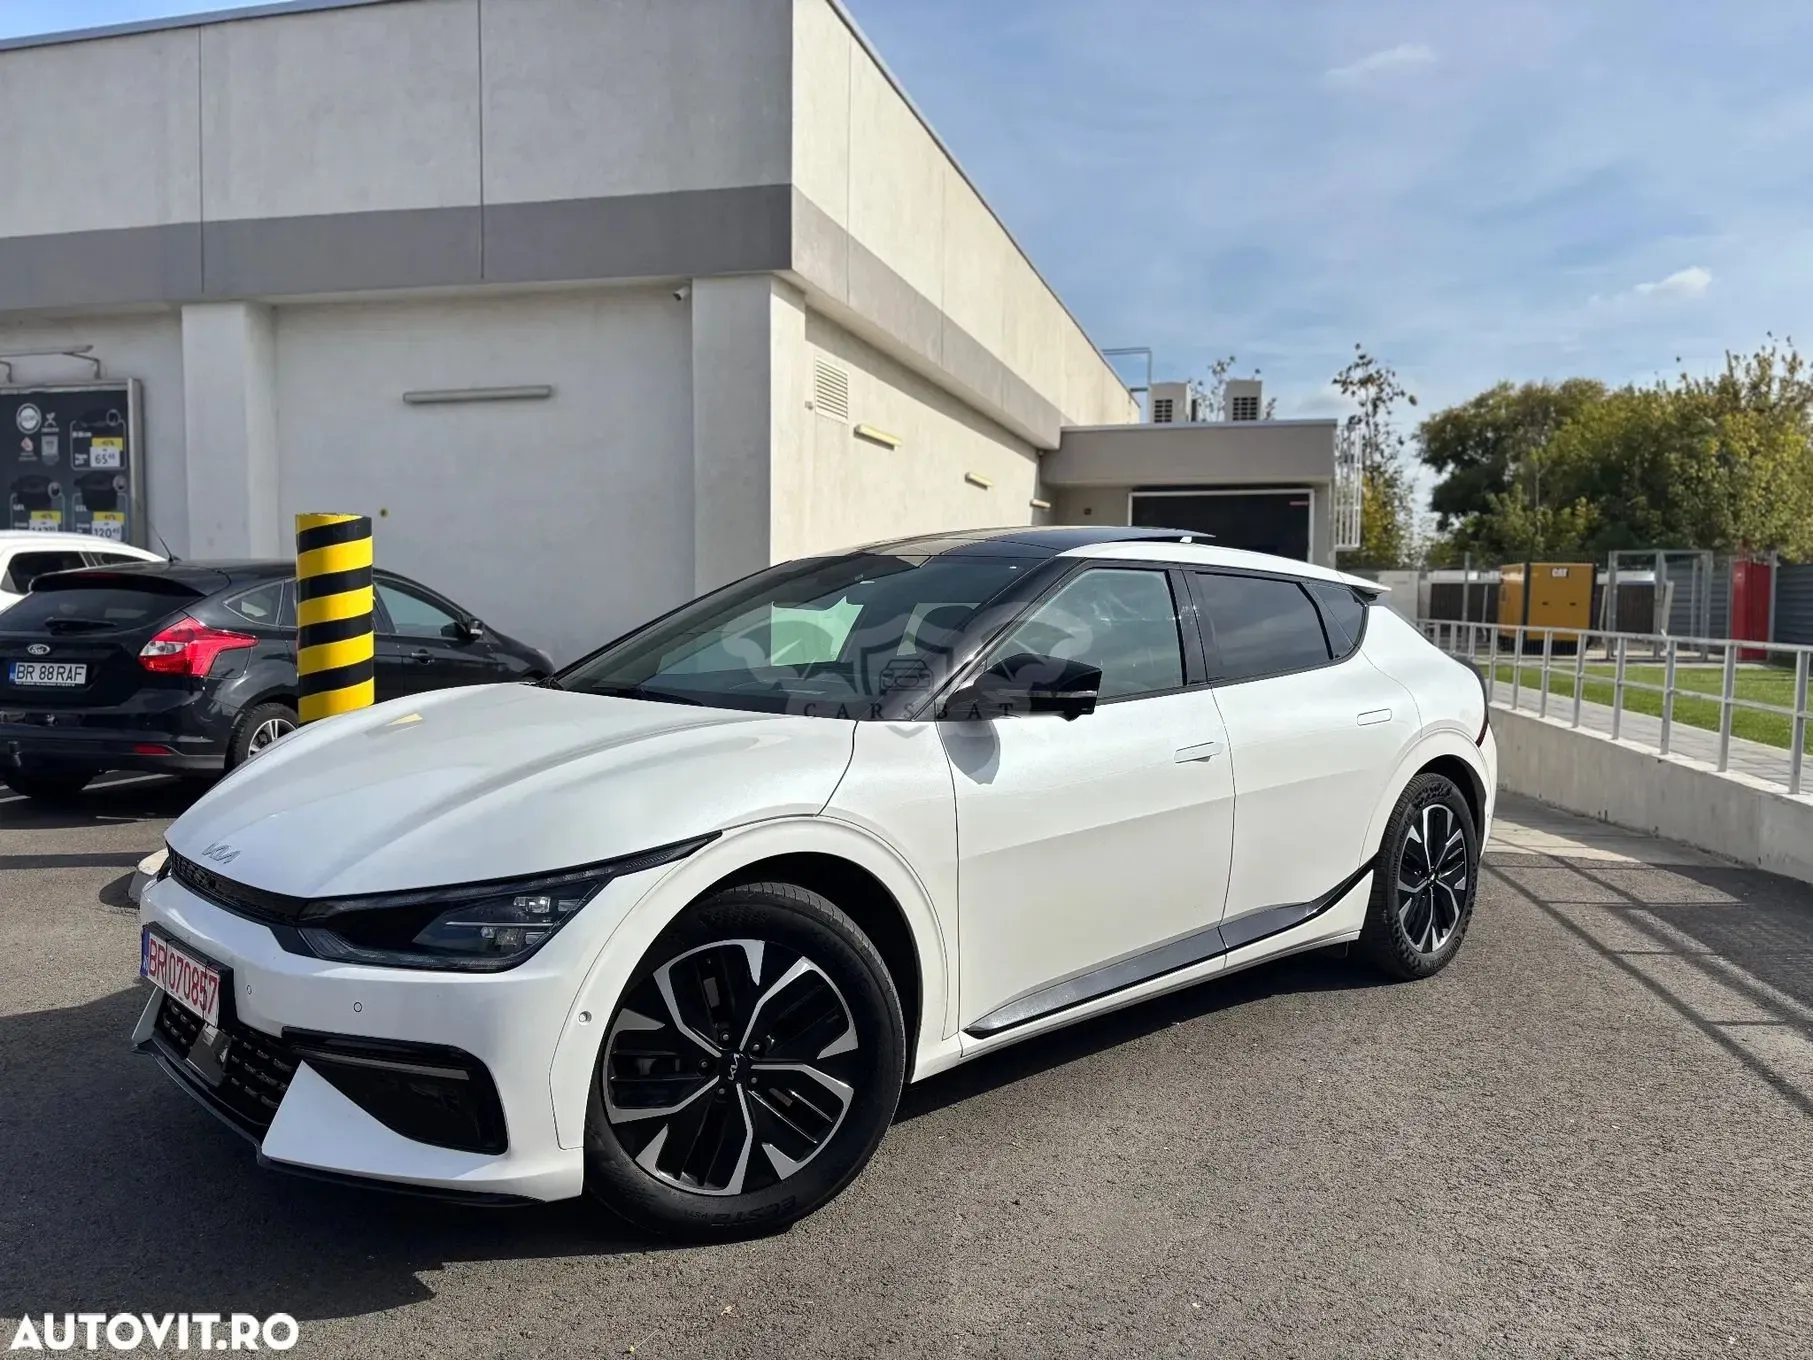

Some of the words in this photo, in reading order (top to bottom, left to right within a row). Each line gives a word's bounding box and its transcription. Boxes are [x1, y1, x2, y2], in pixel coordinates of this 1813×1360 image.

[17, 665, 35, 680] BR
[39, 665, 55, 680] 88
[56, 666, 84, 681] RAF
[148, 938, 167, 985] BR
[169, 952, 217, 1015] 070857
